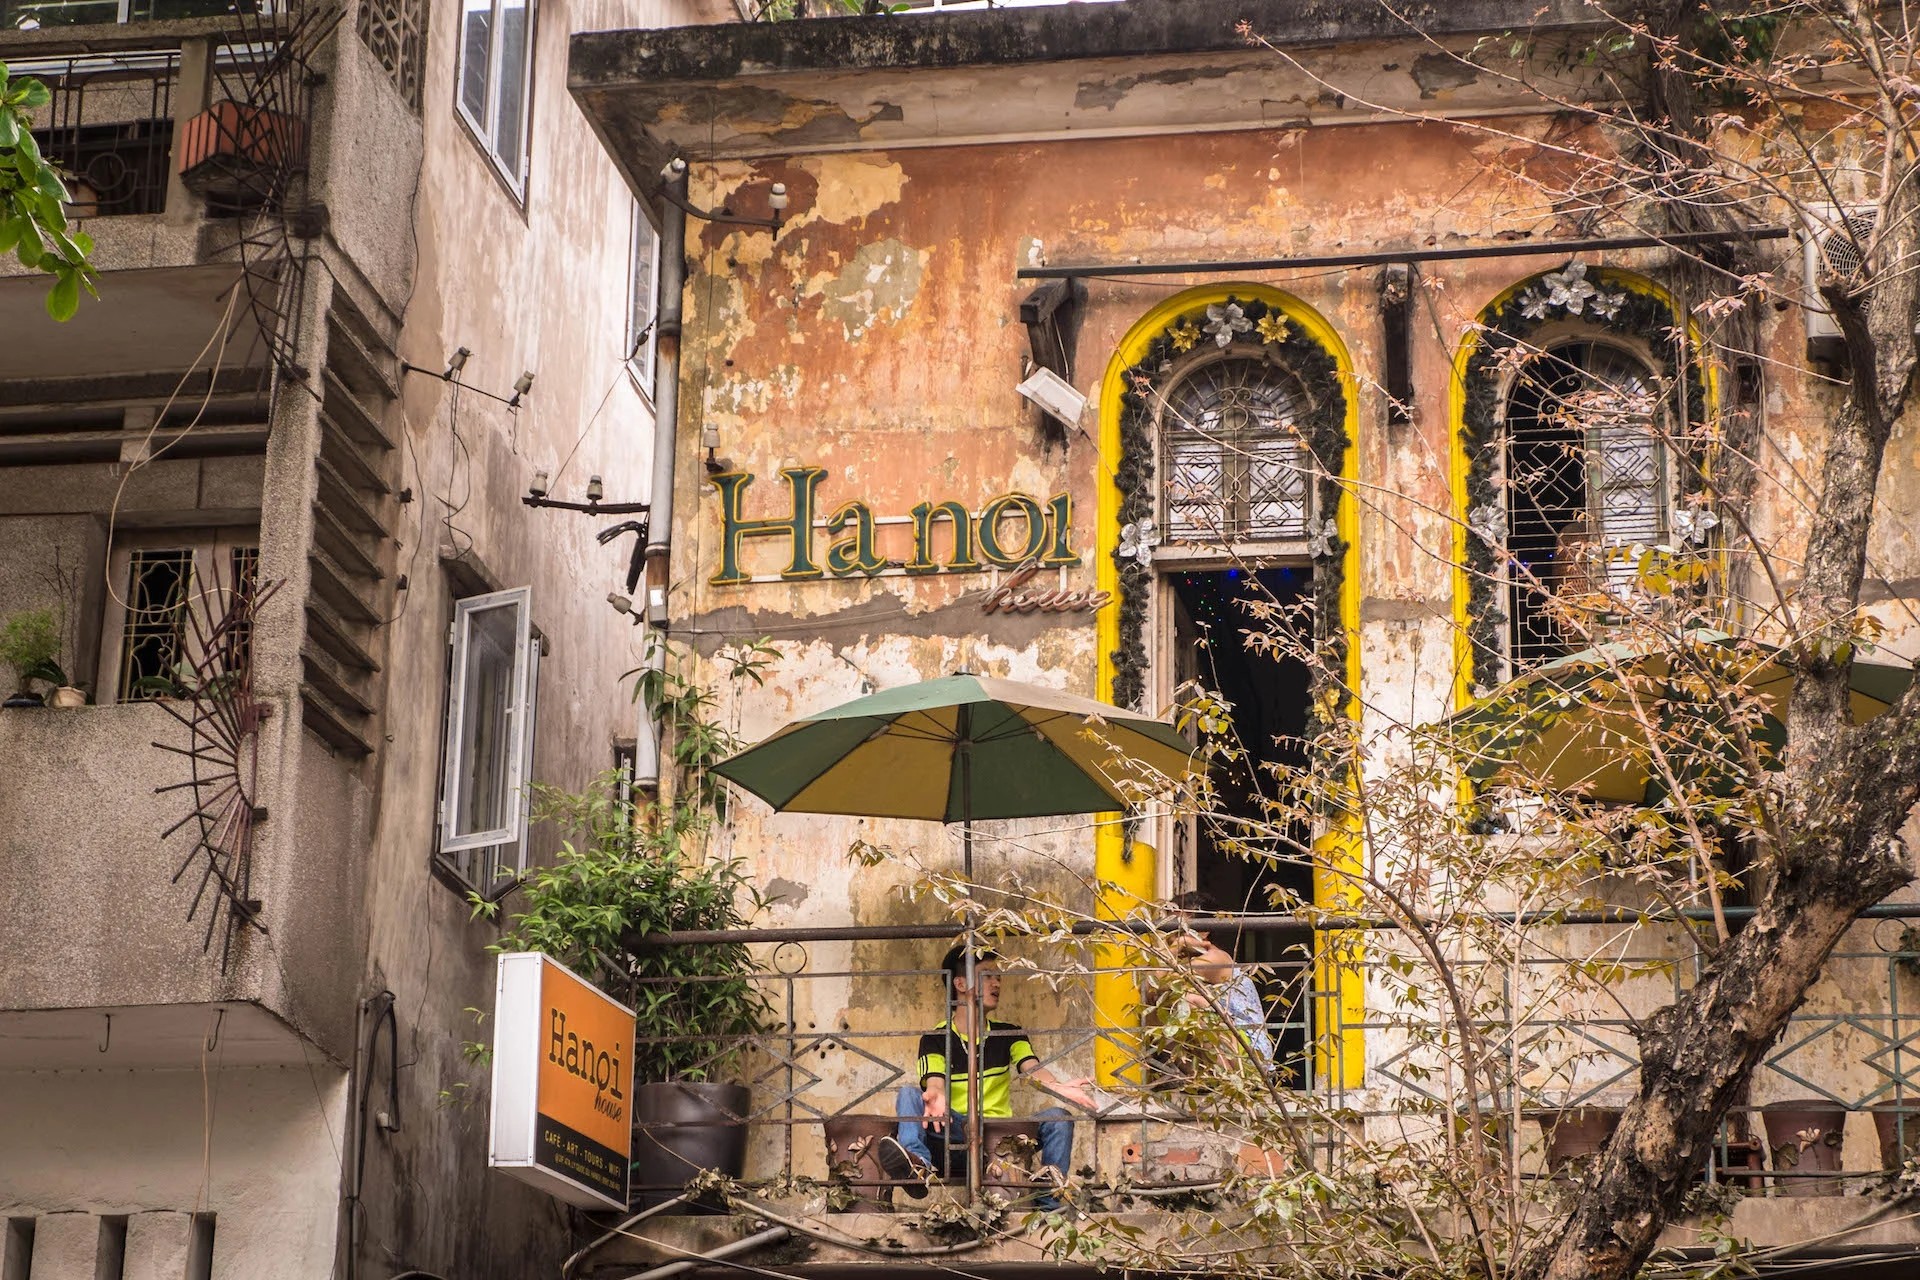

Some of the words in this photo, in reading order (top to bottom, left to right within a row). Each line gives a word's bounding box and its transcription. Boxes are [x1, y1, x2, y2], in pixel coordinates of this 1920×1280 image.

[708, 465, 1081, 585] Hanoi
[980, 556, 1114, 615] house
[548, 1007, 623, 1100] Hanoi
[594, 1085, 623, 1124] house
[566, 1141, 579, 1157] ART
[584, 1149, 604, 1169] TOURS
[608, 1161, 621, 1178] WIFI
